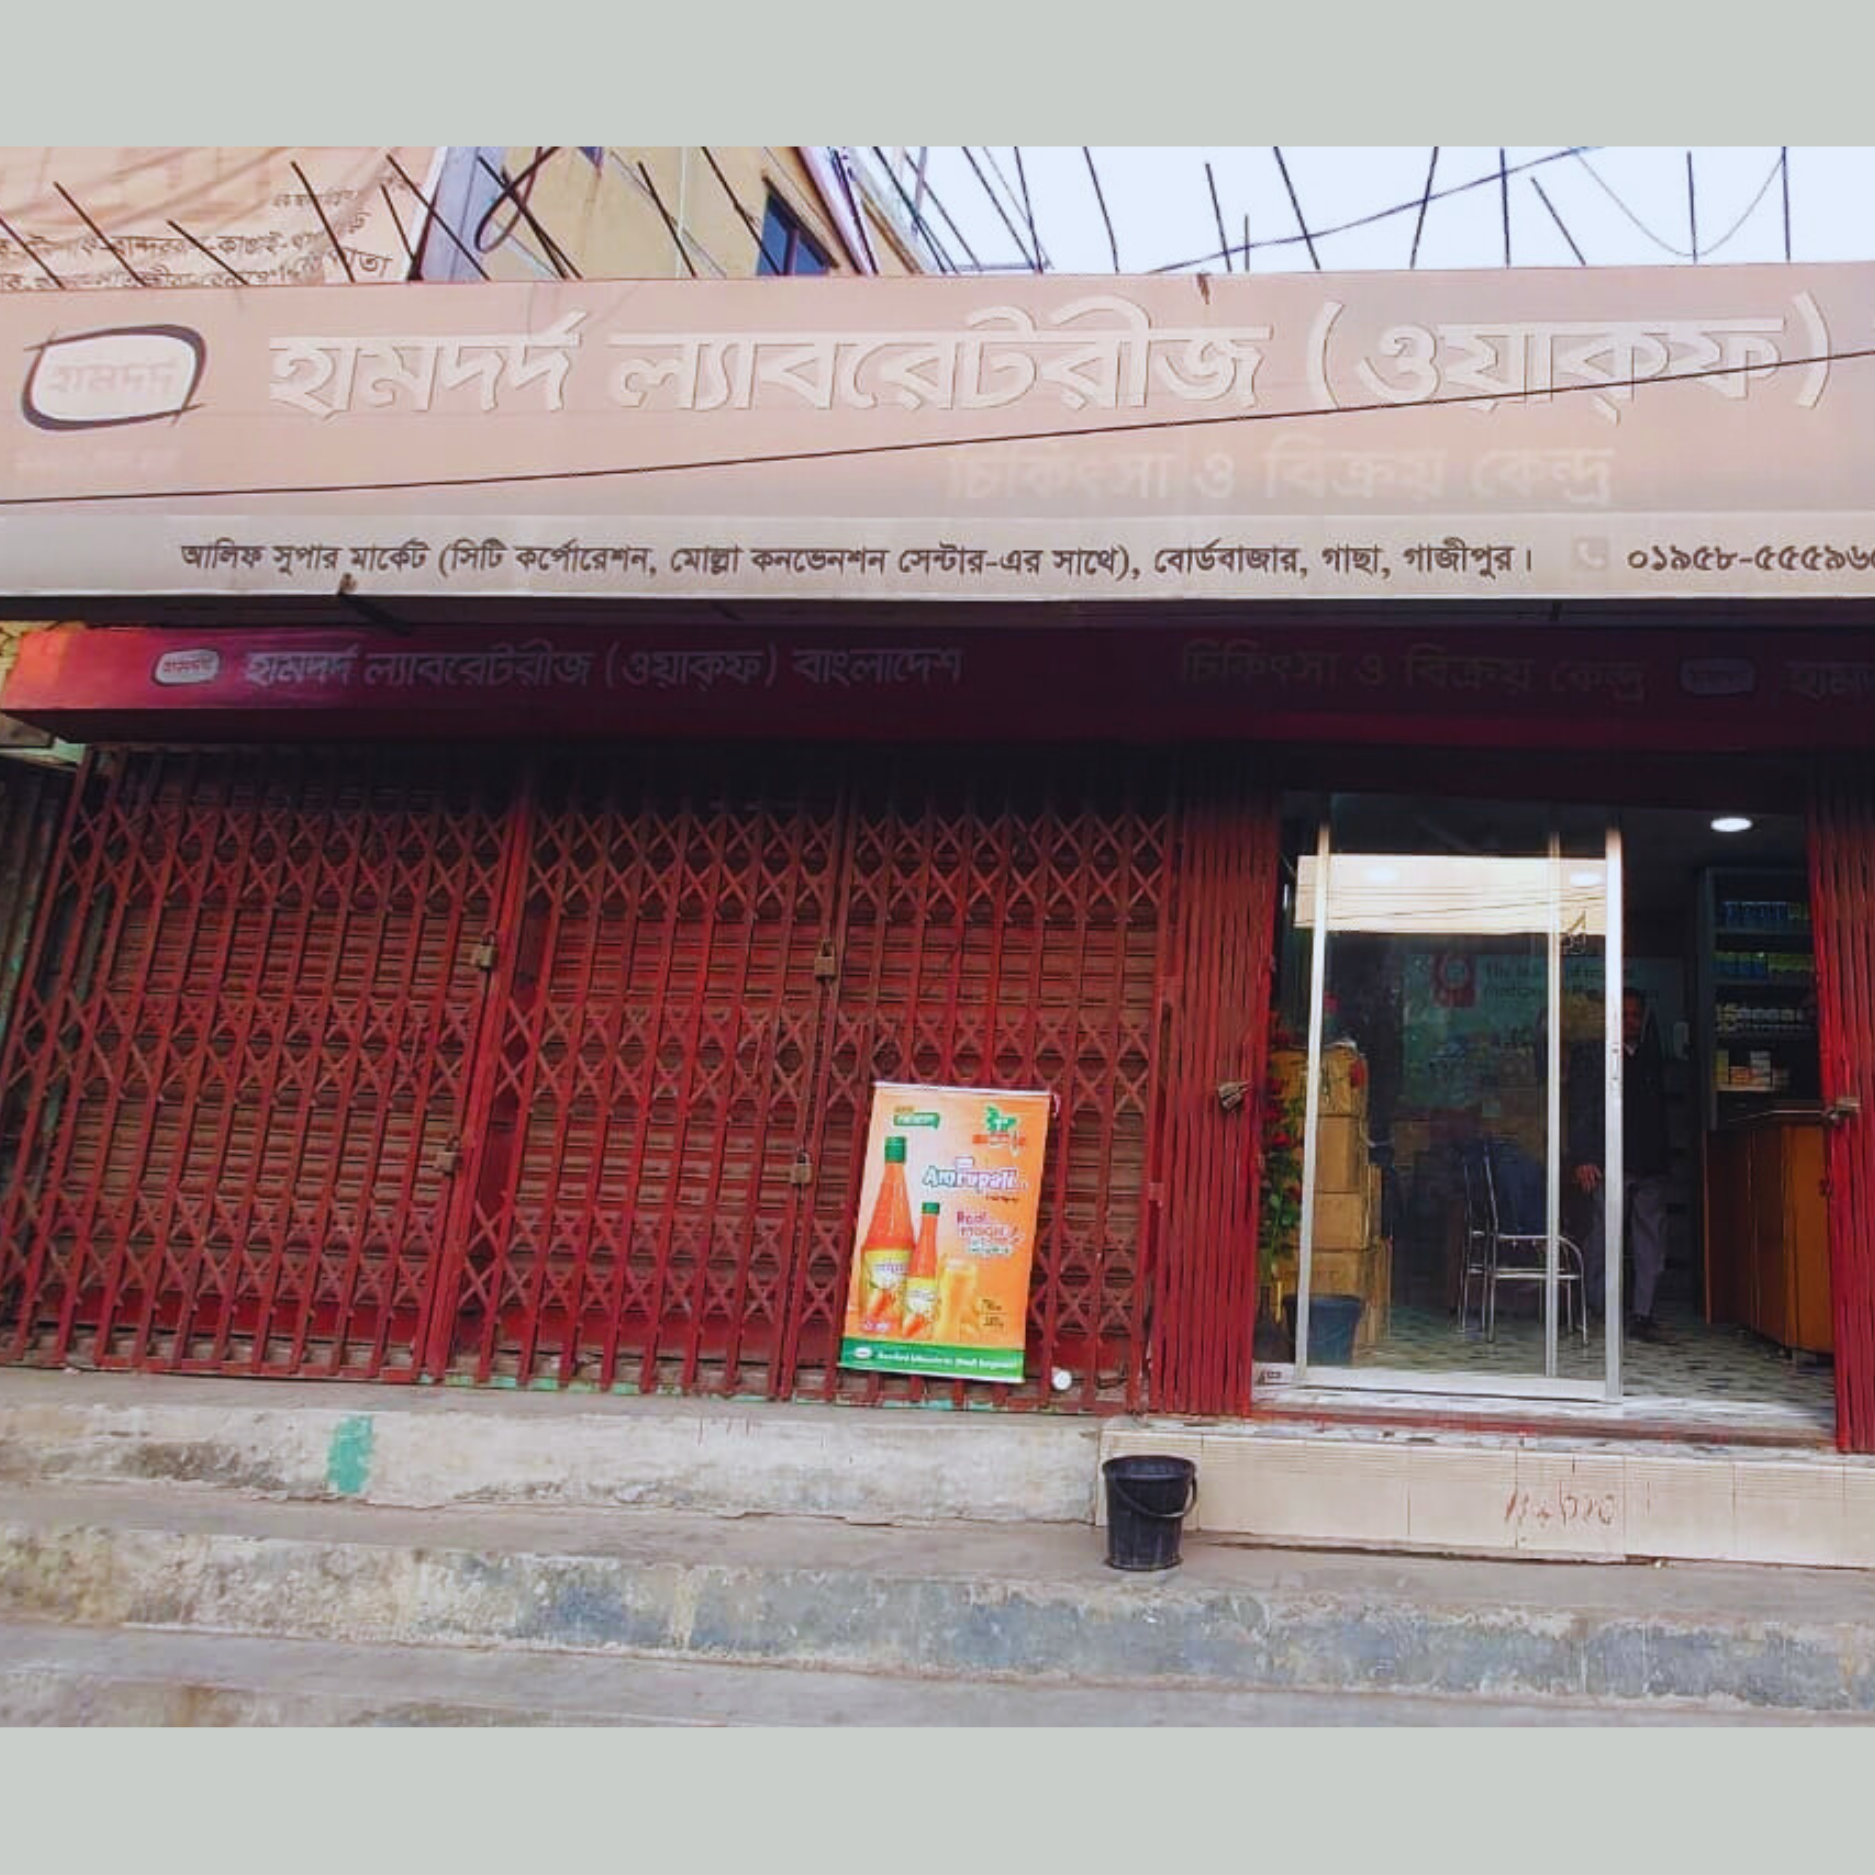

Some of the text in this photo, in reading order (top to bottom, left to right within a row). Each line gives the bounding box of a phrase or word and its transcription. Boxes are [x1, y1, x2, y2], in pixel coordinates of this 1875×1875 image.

[270, 310, 590, 420] হামদর্দ
[606, 294, 1274, 412] ল্যাবরেটরীজ
[948, 434, 1616, 510] চিকিৎসা ও বিক্রয় কেন্দ্র
[181, 538, 263, 570] আলিফ
[272, 545, 341, 576] সুপার
[350, 540, 428, 573] মার্কেট
[438, 537, 504, 577] (সিটি
[514, 540, 657, 578] কর্পোরেশন,
[670, 544, 742, 576] মোল্লা
[751, 544, 890, 576] কনভেনশন
[897, 541, 1042, 576] সেন্টার-এর
[1051, 545, 1142, 582] সাথে),
[1153, 538, 1308, 579] বোর্ডবাজার,
[1321, 544, 1392, 580] গাছা,
[245, 644, 358, 687] হামদর্দ
[366, 639, 594, 687] ল্যাবরেটরীজ
[792, 646, 965, 686] বাংলাদেশ
